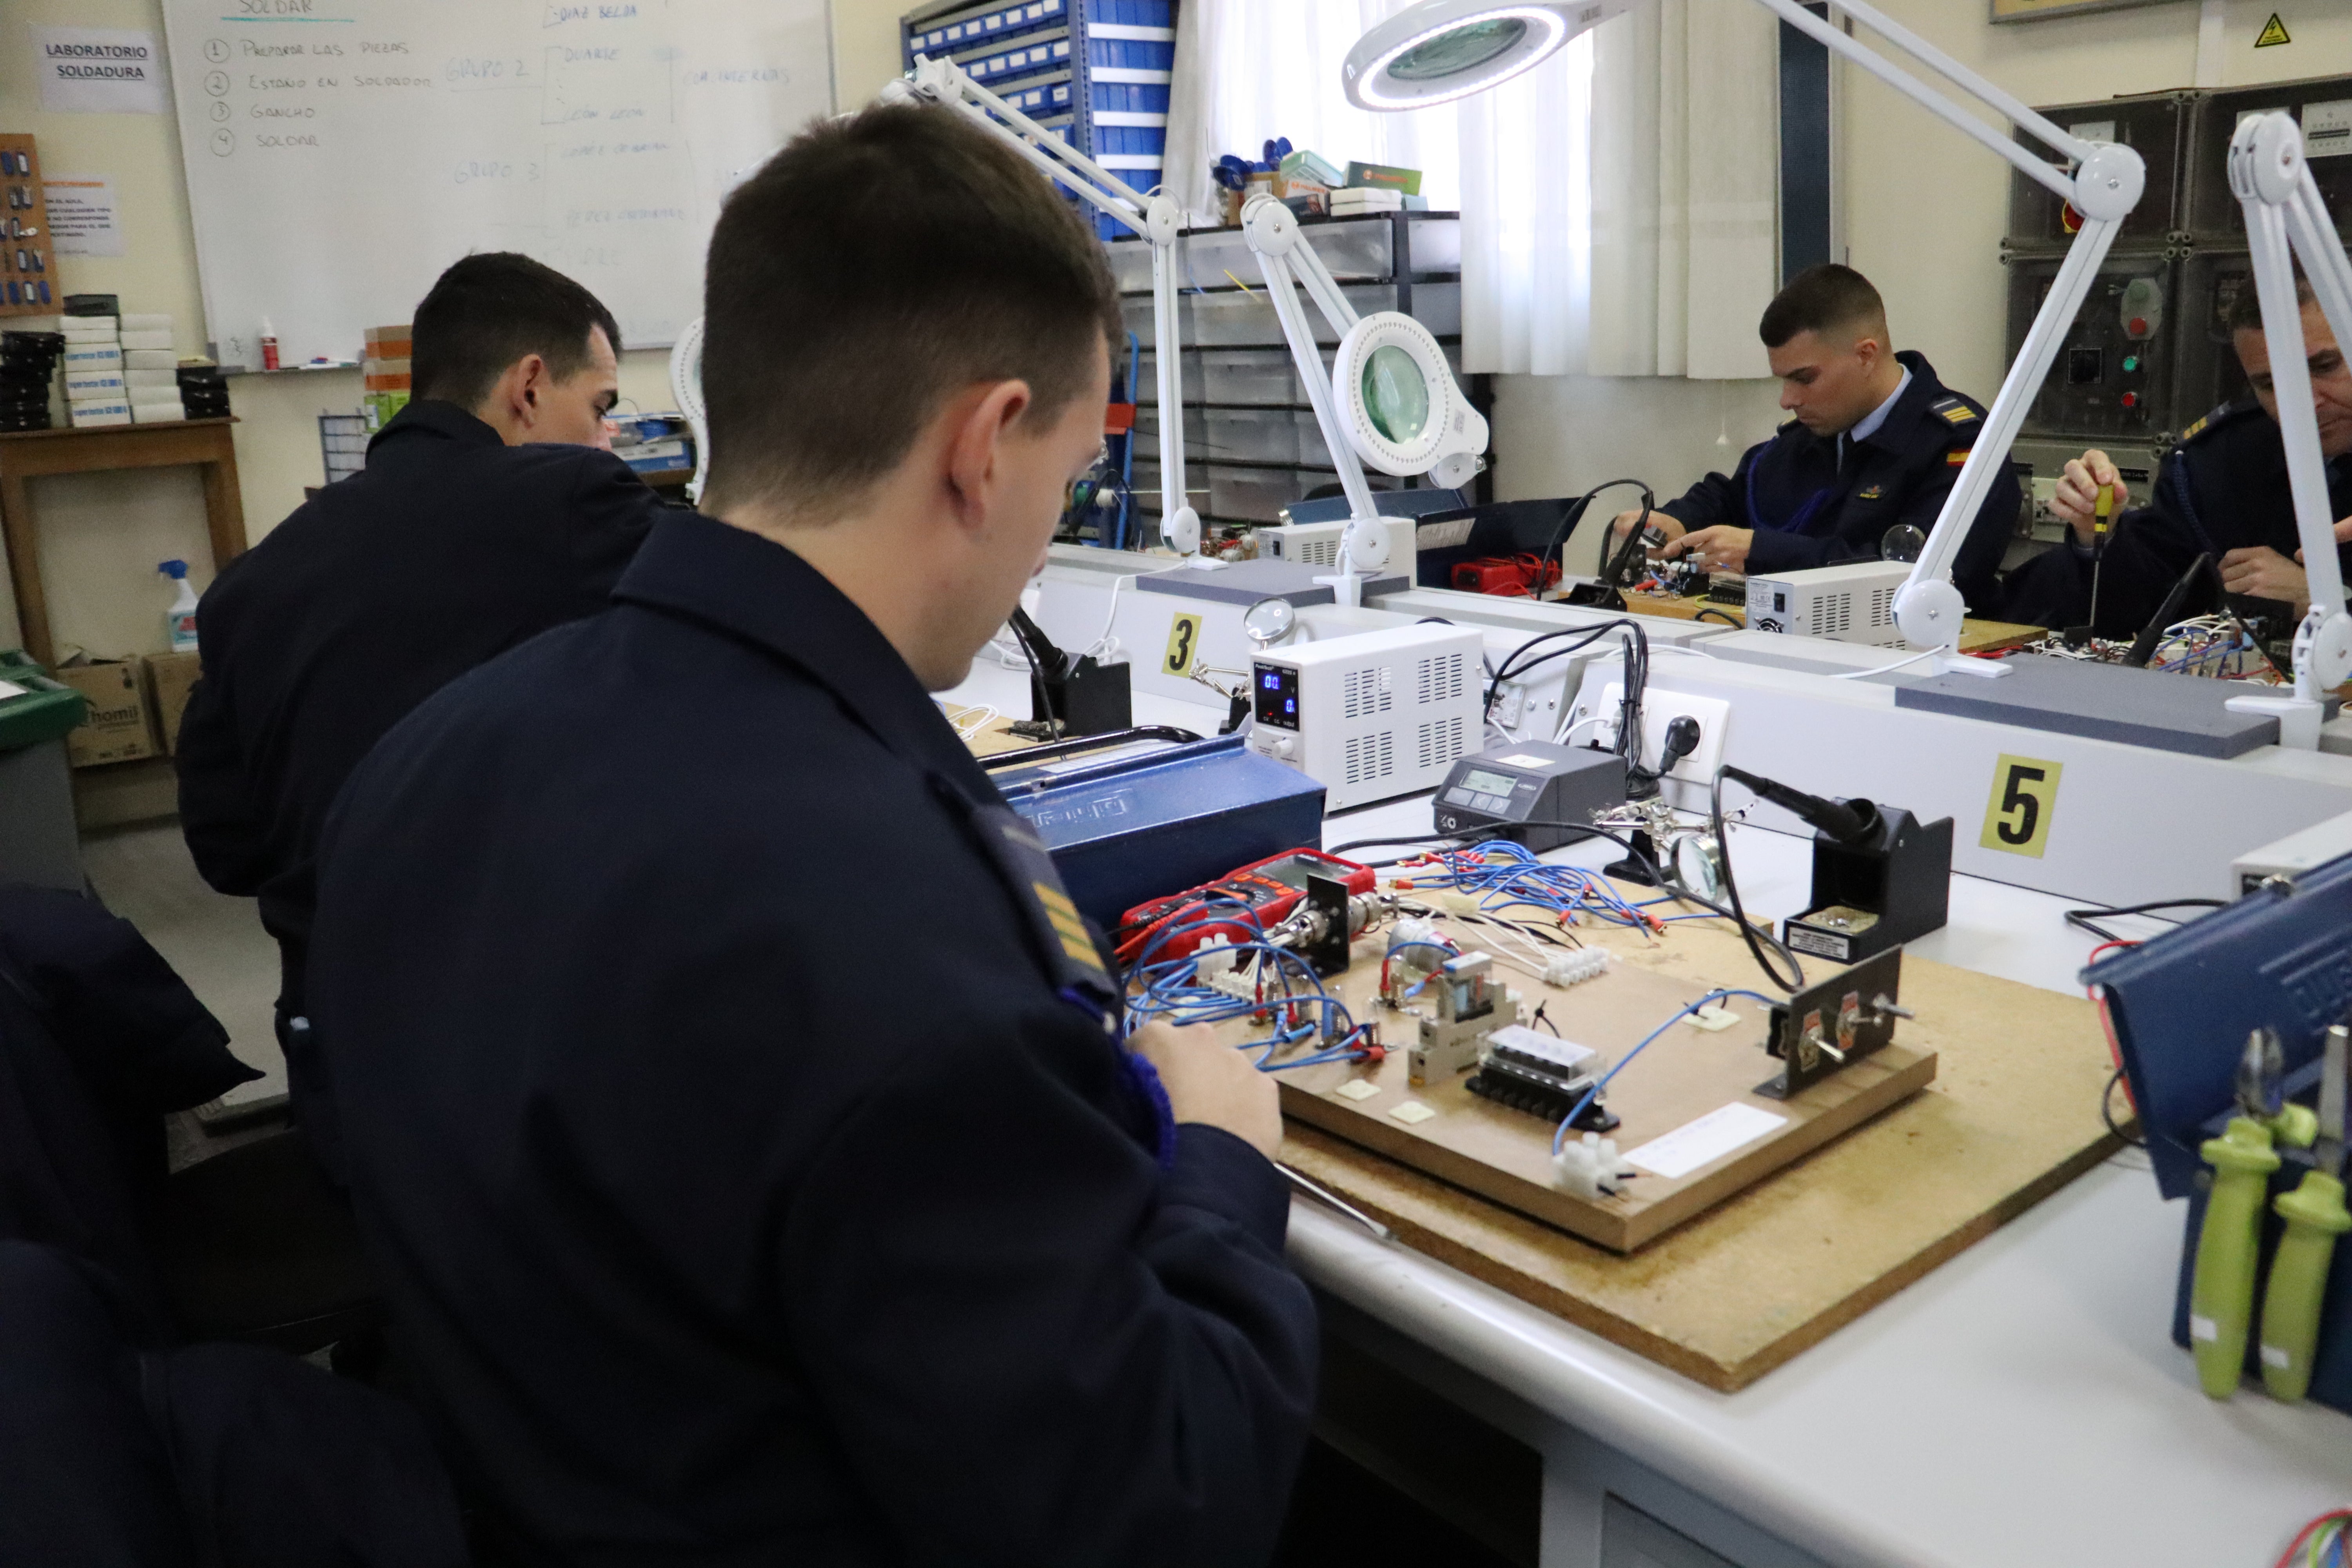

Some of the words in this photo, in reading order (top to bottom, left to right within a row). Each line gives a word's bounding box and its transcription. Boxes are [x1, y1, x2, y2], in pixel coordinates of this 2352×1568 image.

[46, 44, 147, 58] LABORATORIO
[313, 44, 345, 56] LAS
[361, 40, 410, 54] PIEZAS
[565, 47, 619, 62] DUARTE
[57, 65, 144, 79] SOLDADURA
[446, 57, 504, 81] GRUPO
[515, 60, 530, 76] 2
[318, 77, 338, 87] EN
[354, 75, 432, 88] SOLDADOR
[250, 103, 315, 119] GANCHO
[256, 134, 320, 147] SOLDAR
[454, 160, 513, 184] GRUPO
[528, 163, 540, 181] 3
[1169, 619, 1192, 671] 3
[1998, 764, 2045, 845] 5
